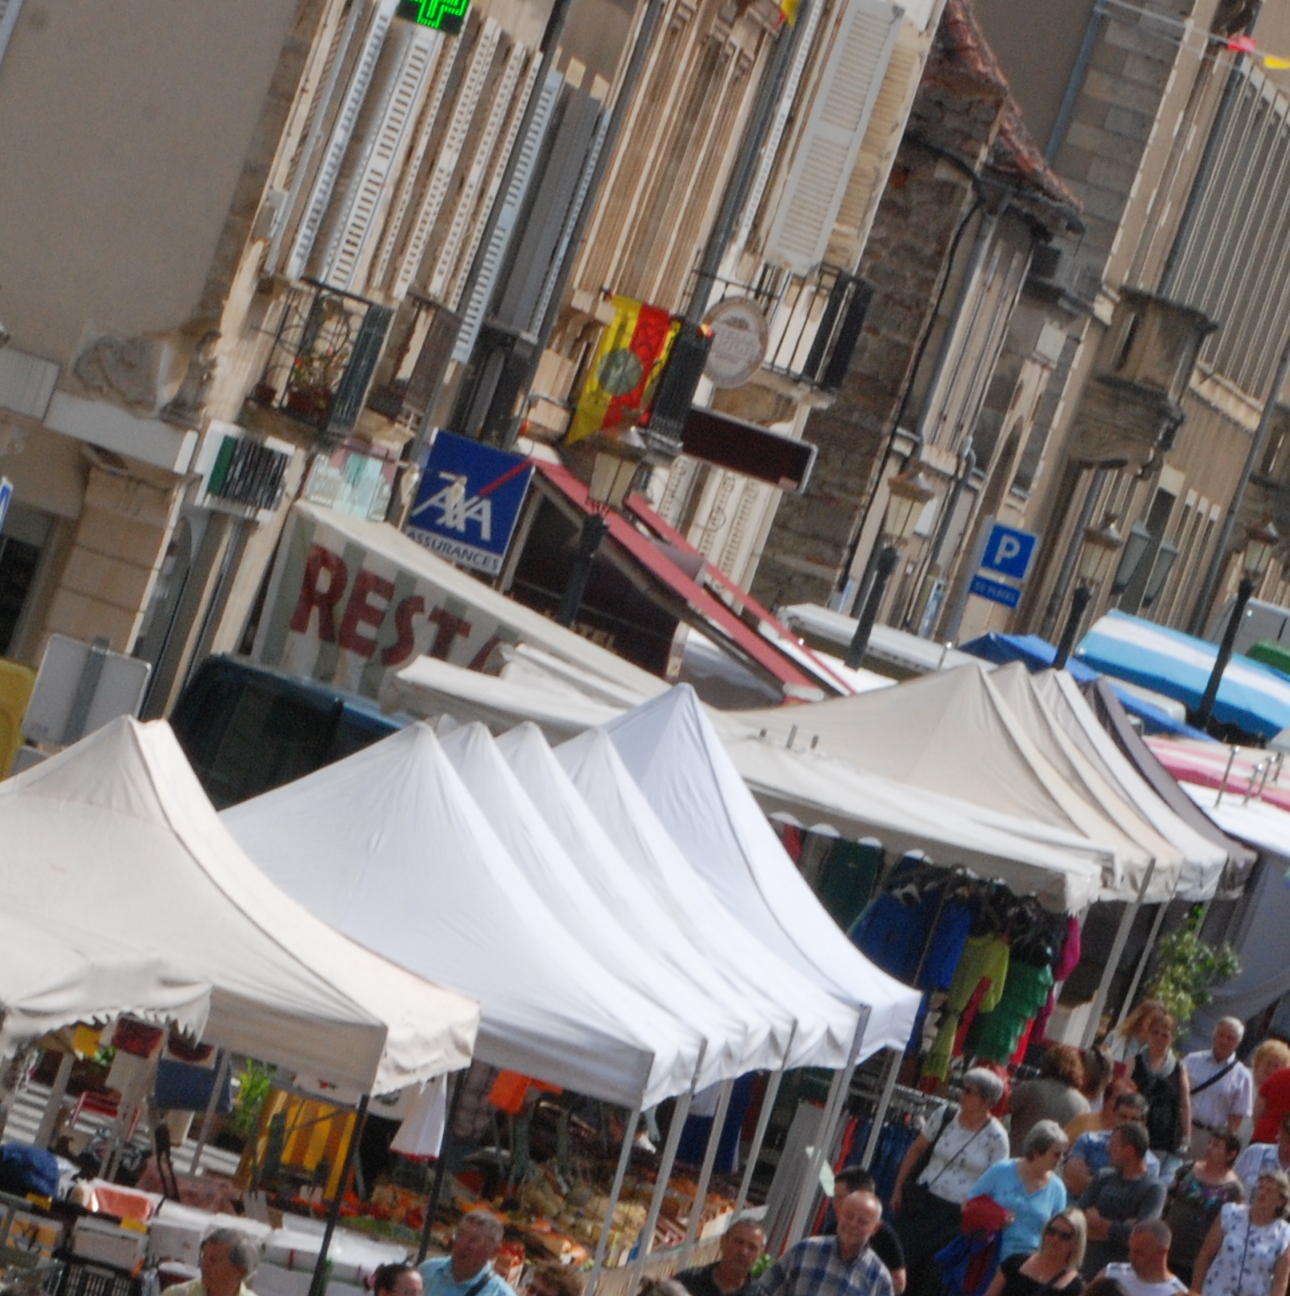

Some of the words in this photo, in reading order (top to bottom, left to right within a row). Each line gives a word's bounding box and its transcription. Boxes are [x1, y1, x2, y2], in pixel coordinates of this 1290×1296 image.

[412, 471, 492, 541] AXA
[408, 530, 500, 570] ASSURANCES
[994, 534, 1021, 565] P
